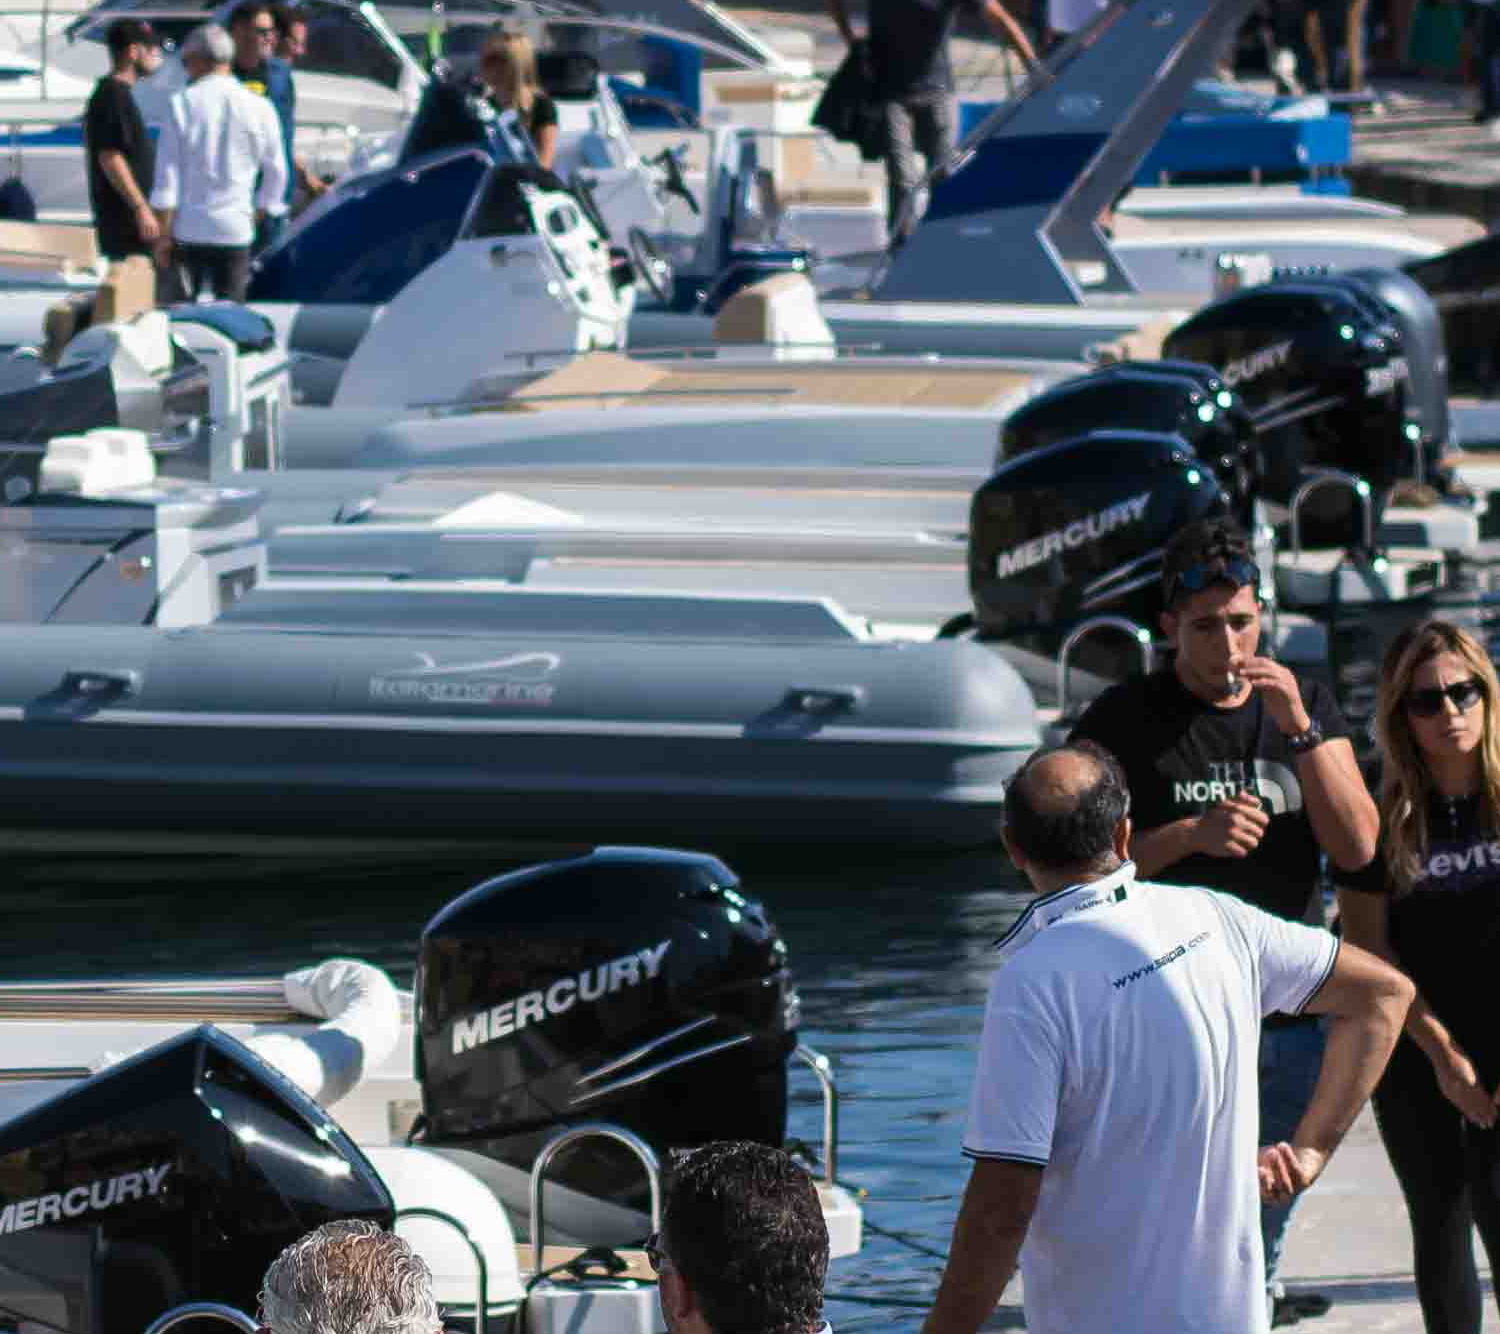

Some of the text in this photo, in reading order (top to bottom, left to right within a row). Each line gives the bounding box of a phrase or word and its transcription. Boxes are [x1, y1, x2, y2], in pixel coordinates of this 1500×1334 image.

[1222, 338, 1295, 387] CURY
[996, 491, 1151, 579] MERCURY
[452, 939, 672, 1056] MERCURY
